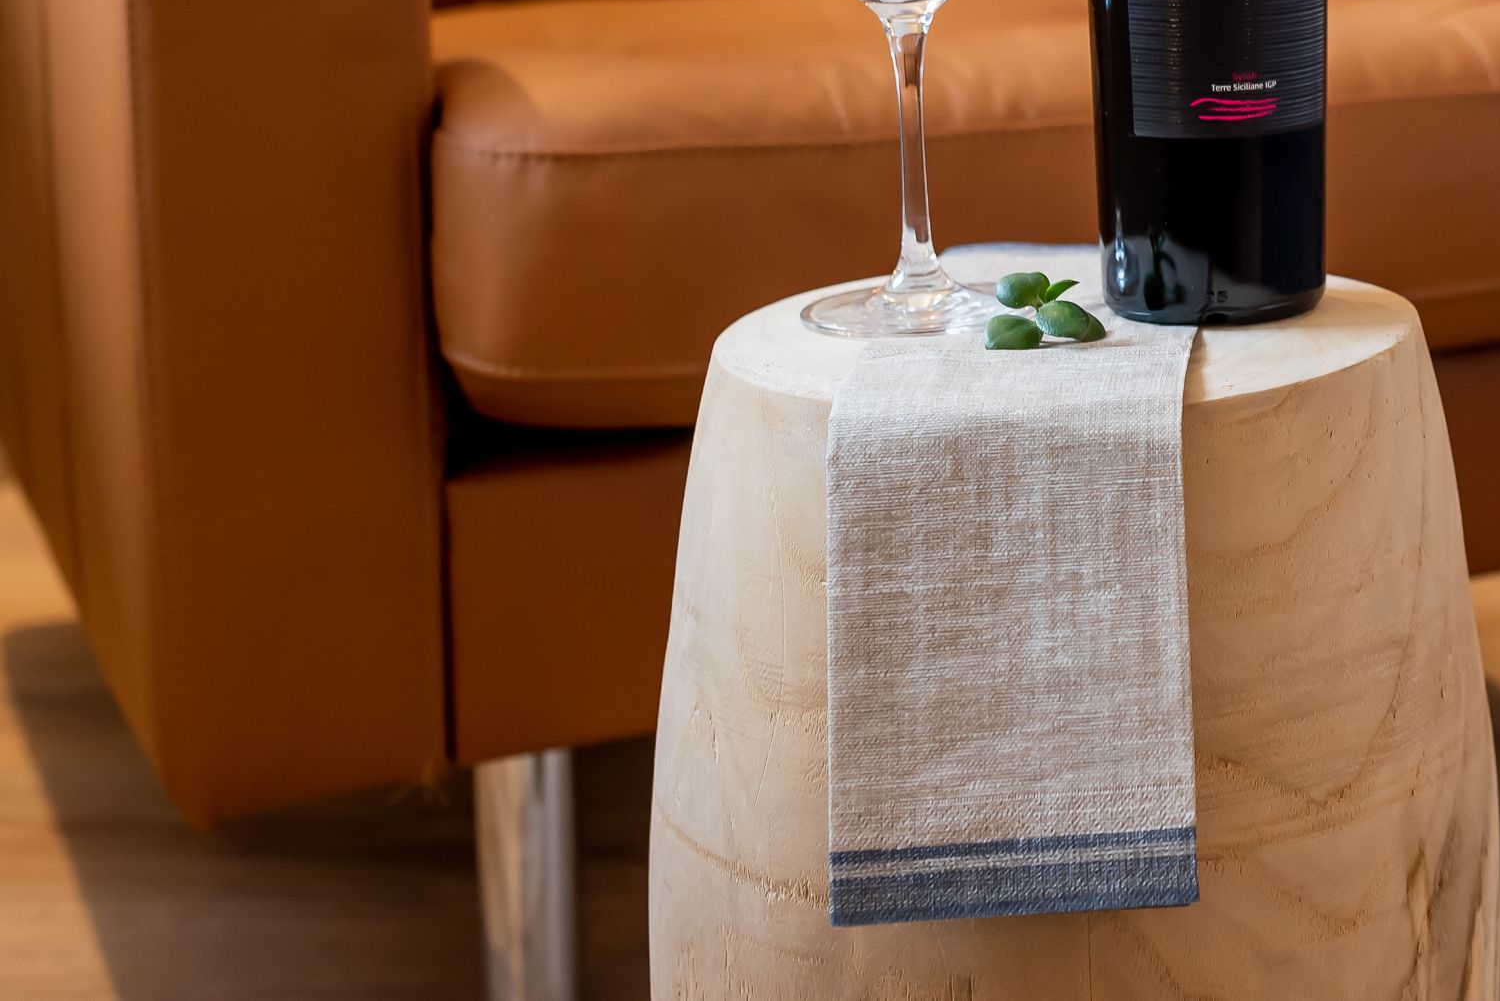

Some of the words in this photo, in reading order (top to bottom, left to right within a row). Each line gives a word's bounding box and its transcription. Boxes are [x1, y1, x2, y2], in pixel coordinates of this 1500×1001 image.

[1211, 83, 1231, 92] Terre
[1233, 81, 1264, 91] Siciliane
[1265, 80, 1277, 89] IGP
